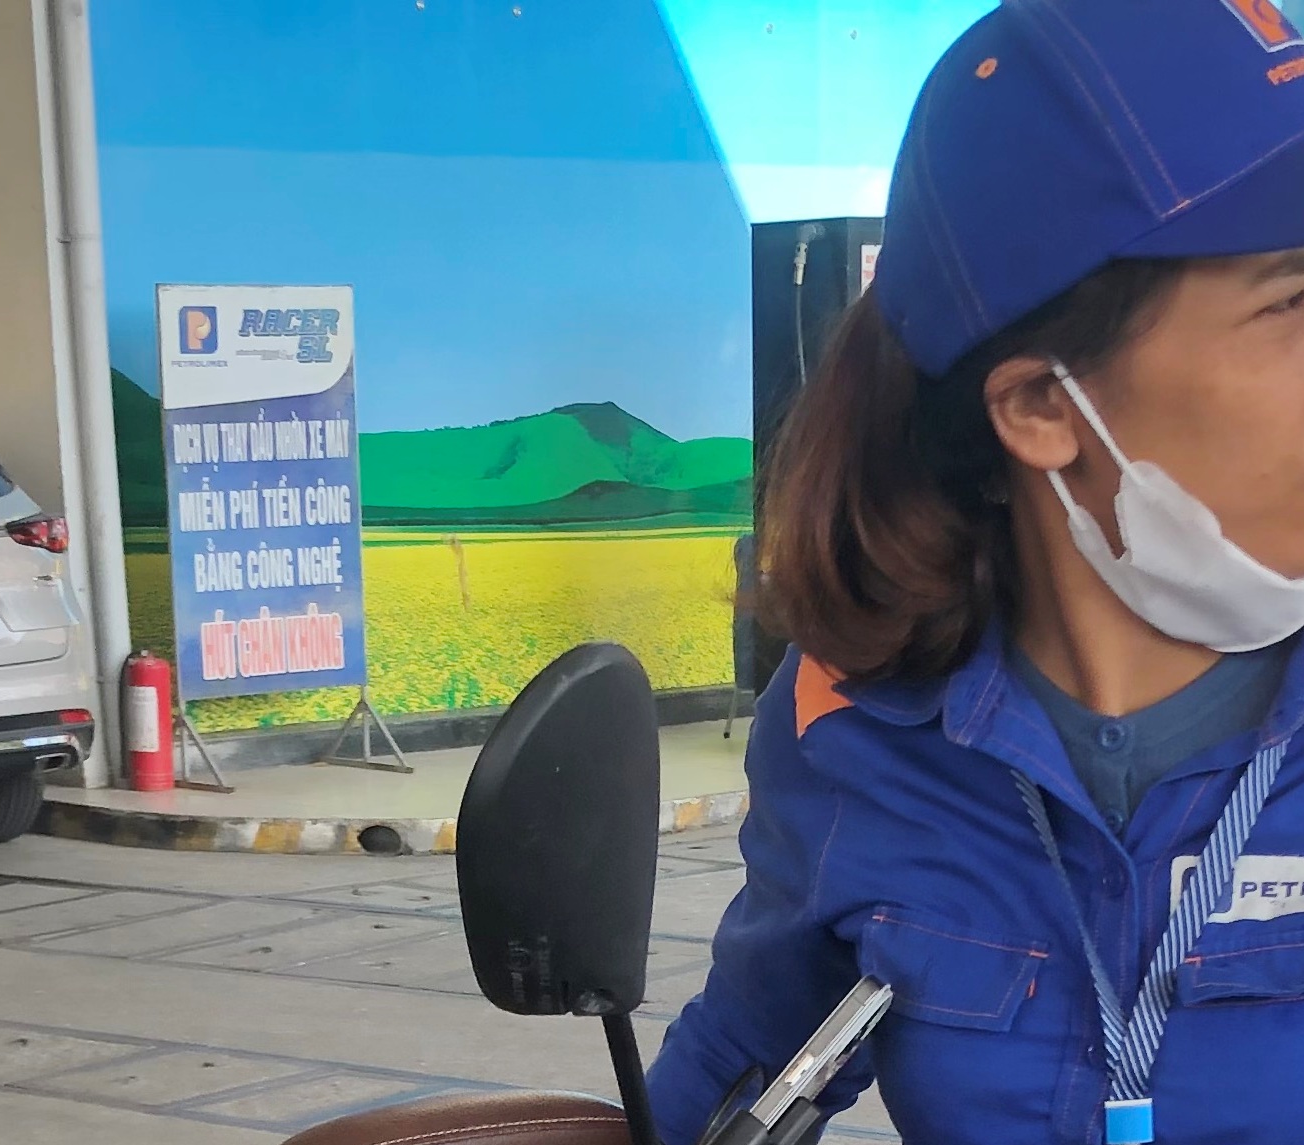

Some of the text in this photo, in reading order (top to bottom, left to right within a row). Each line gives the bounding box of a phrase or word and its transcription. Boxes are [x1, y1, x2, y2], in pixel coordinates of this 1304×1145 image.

[238, 308, 341, 337] RACER
[179, 476, 226, 532] MIỄN
[229, 480, 259, 530] PHÍ
[305, 478, 351, 525] CÔNG
[194, 537, 343, 593] BẰNG CÔNG NGHỆ
[201, 602, 345, 680] HÚT CHÂN KHÔNG
